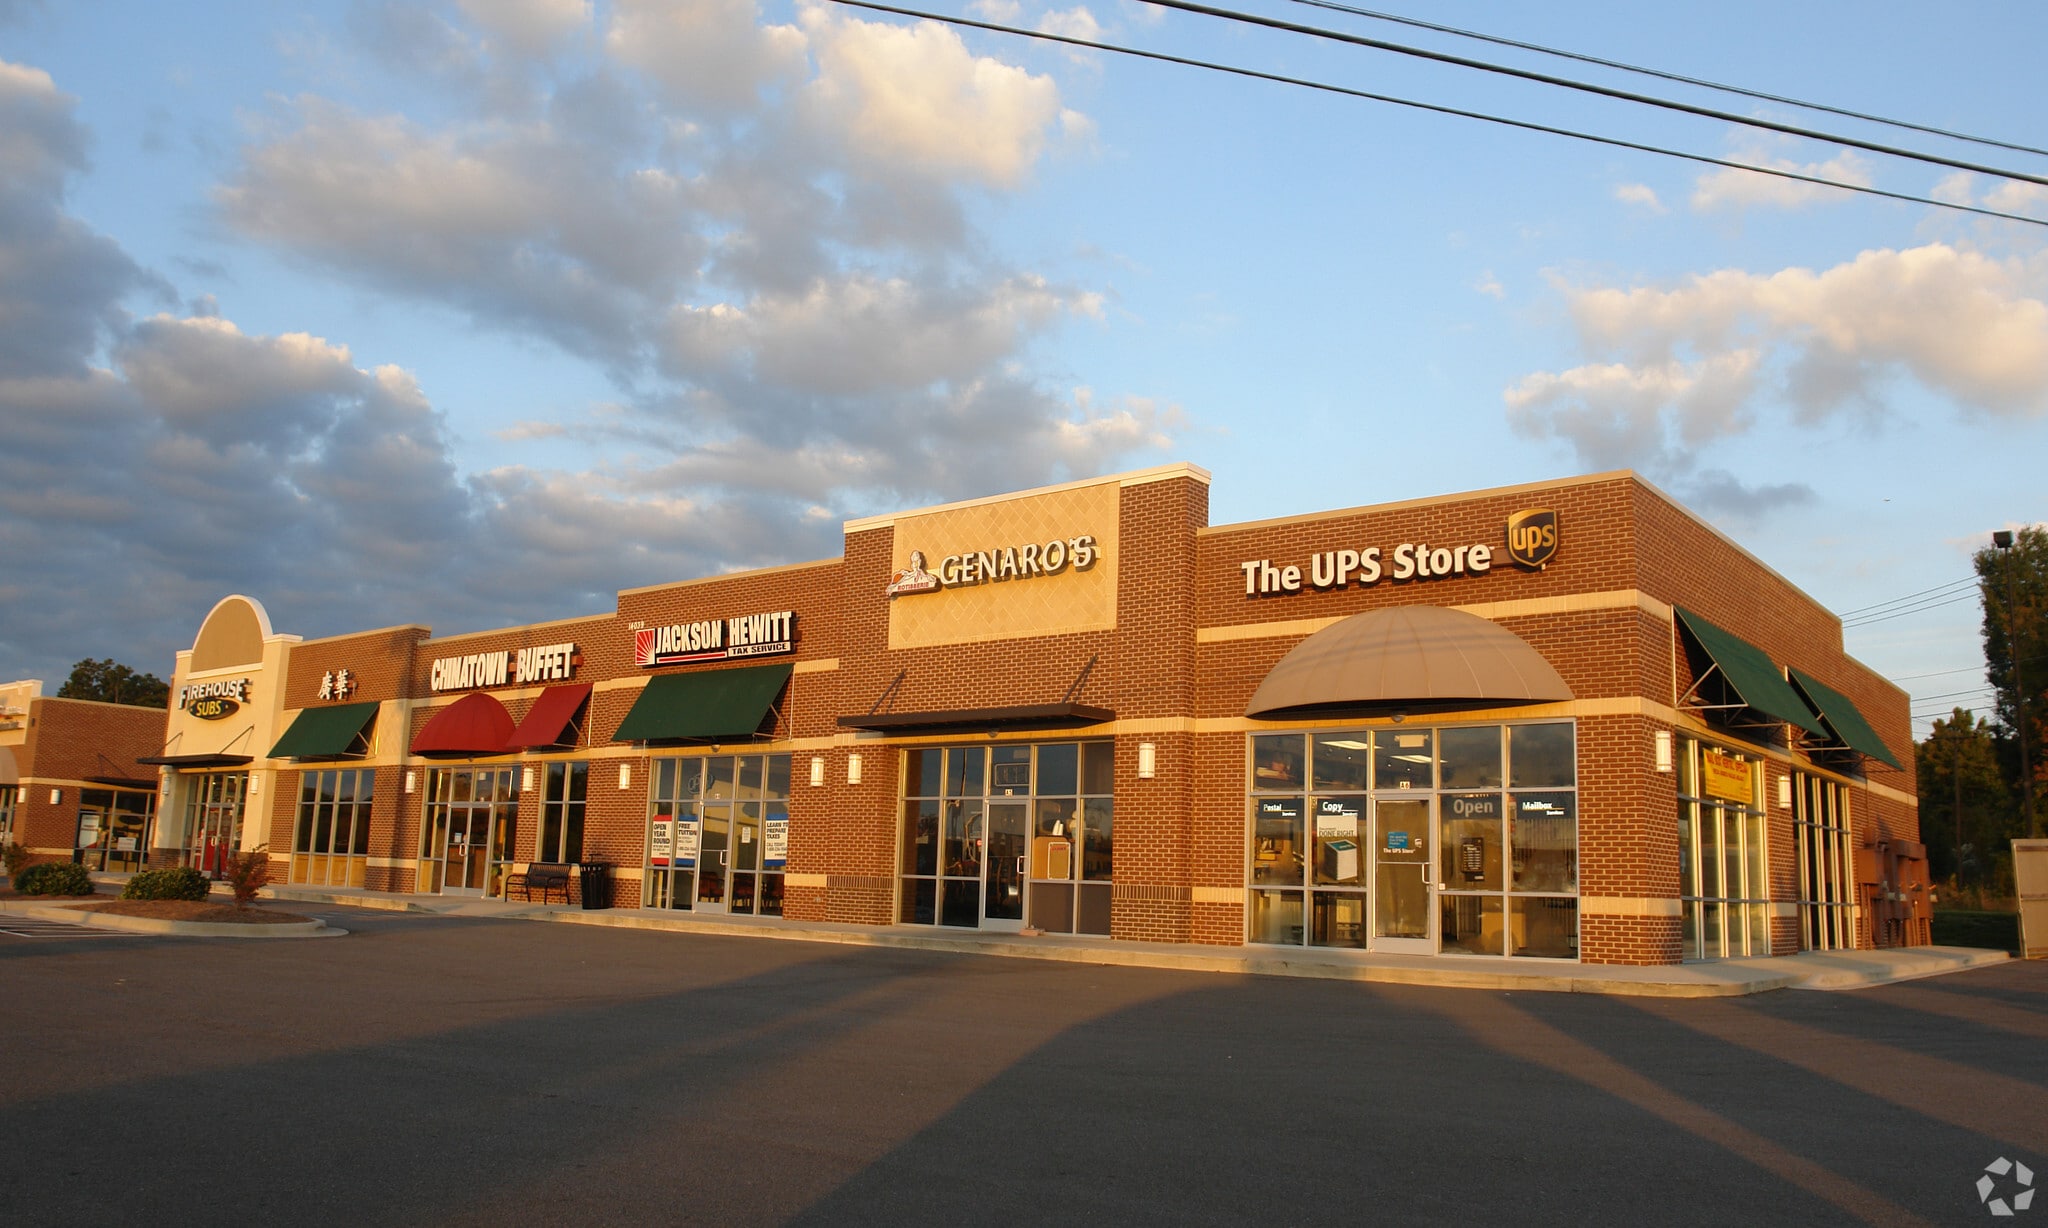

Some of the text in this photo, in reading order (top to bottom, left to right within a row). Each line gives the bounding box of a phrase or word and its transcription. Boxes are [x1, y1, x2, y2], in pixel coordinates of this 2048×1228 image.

[1512, 525, 1556, 558] ups
[939, 535, 1092, 585] GENARO'S
[1242, 543, 1490, 594] The UPS Store
[655, 611, 792, 654] JACKSON HEWITT
[732, 643, 788, 656] TAX SERVICE
[431, 643, 575, 691] CHINATOWN BUFFET
[179, 678, 246, 708] FIREHOUSE
[196, 700, 221, 716] SUBS
[1263, 803, 1282, 811] Postal
[1322, 801, 1344, 813] Copy
[1453, 799, 1494, 818] Open
[1522, 801, 1553, 810] Mailbox
